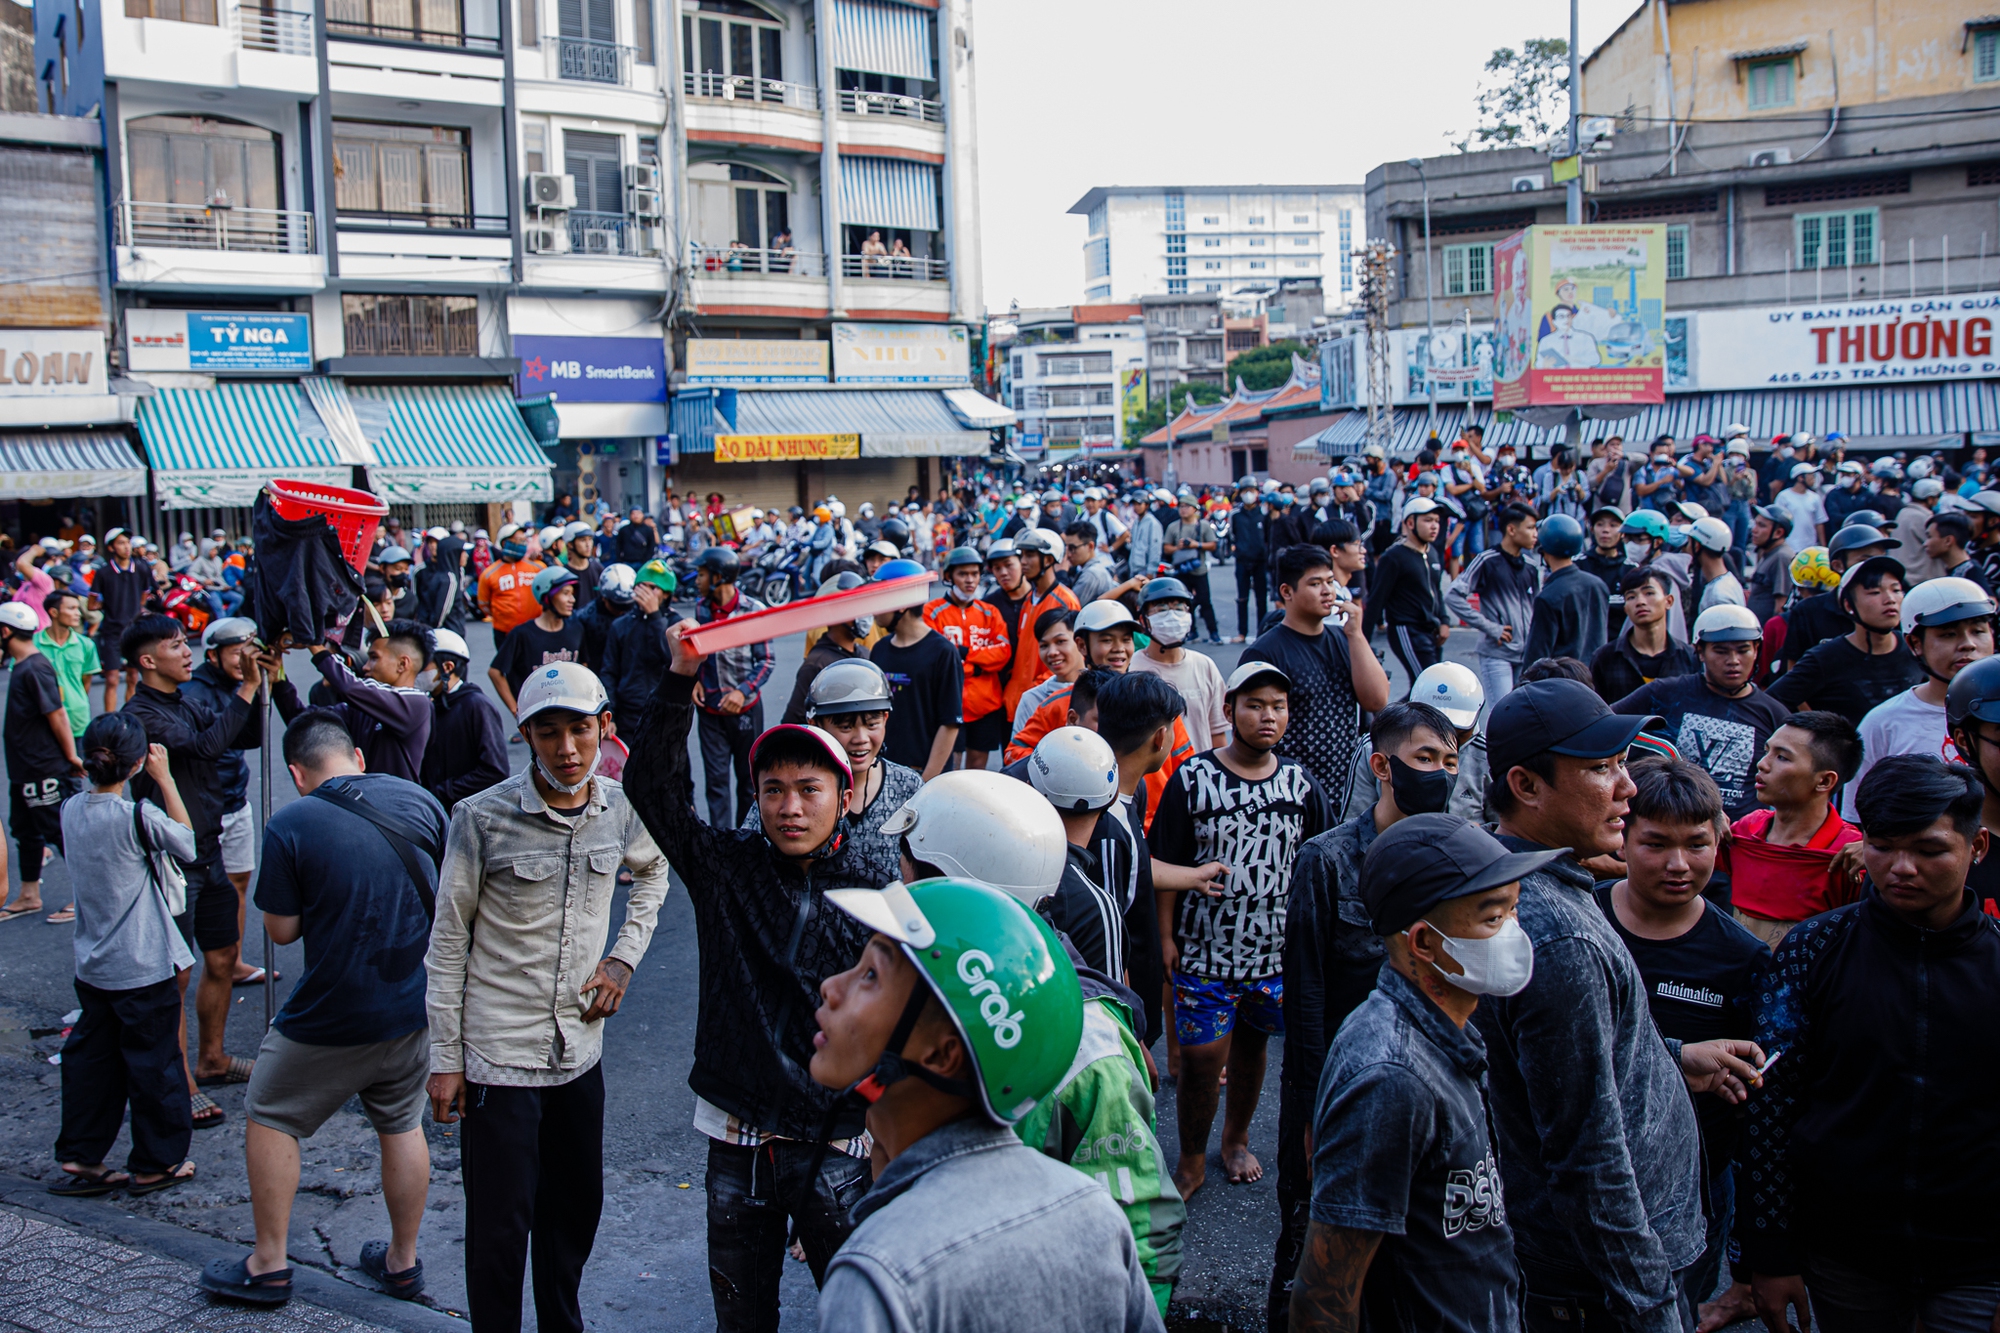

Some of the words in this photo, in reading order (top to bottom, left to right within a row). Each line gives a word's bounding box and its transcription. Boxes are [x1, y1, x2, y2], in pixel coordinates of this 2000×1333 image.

[1802, 309, 1841, 321] BAN
[1847, 303, 1902, 317] NHÂN
[1911, 301, 1951, 313] DÂN
[133, 333, 184, 344] uni
[210, 322, 240, 344] TỶ
[243, 328, 289, 344] NGA
[1810, 315, 1992, 364] THƯƠNG
[551, 361, 582, 379] MB
[586, 365, 655, 379] SmartBank
[1913, 363, 1973, 376] HƯNG
[719, 436, 740, 458] ÁO
[745, 436, 772, 457] DÀI
[777, 439, 828, 456] NHUNG
[471, 481, 542, 491] NGA
[541, 680, 565, 688] PIAGGIO
[1432, 694, 1452, 702] PIAGGIO
[956, 948, 1025, 1049] Grab
[1657, 980, 1724, 1006] minimalism
[1073, 1122, 1147, 1162] Grab
